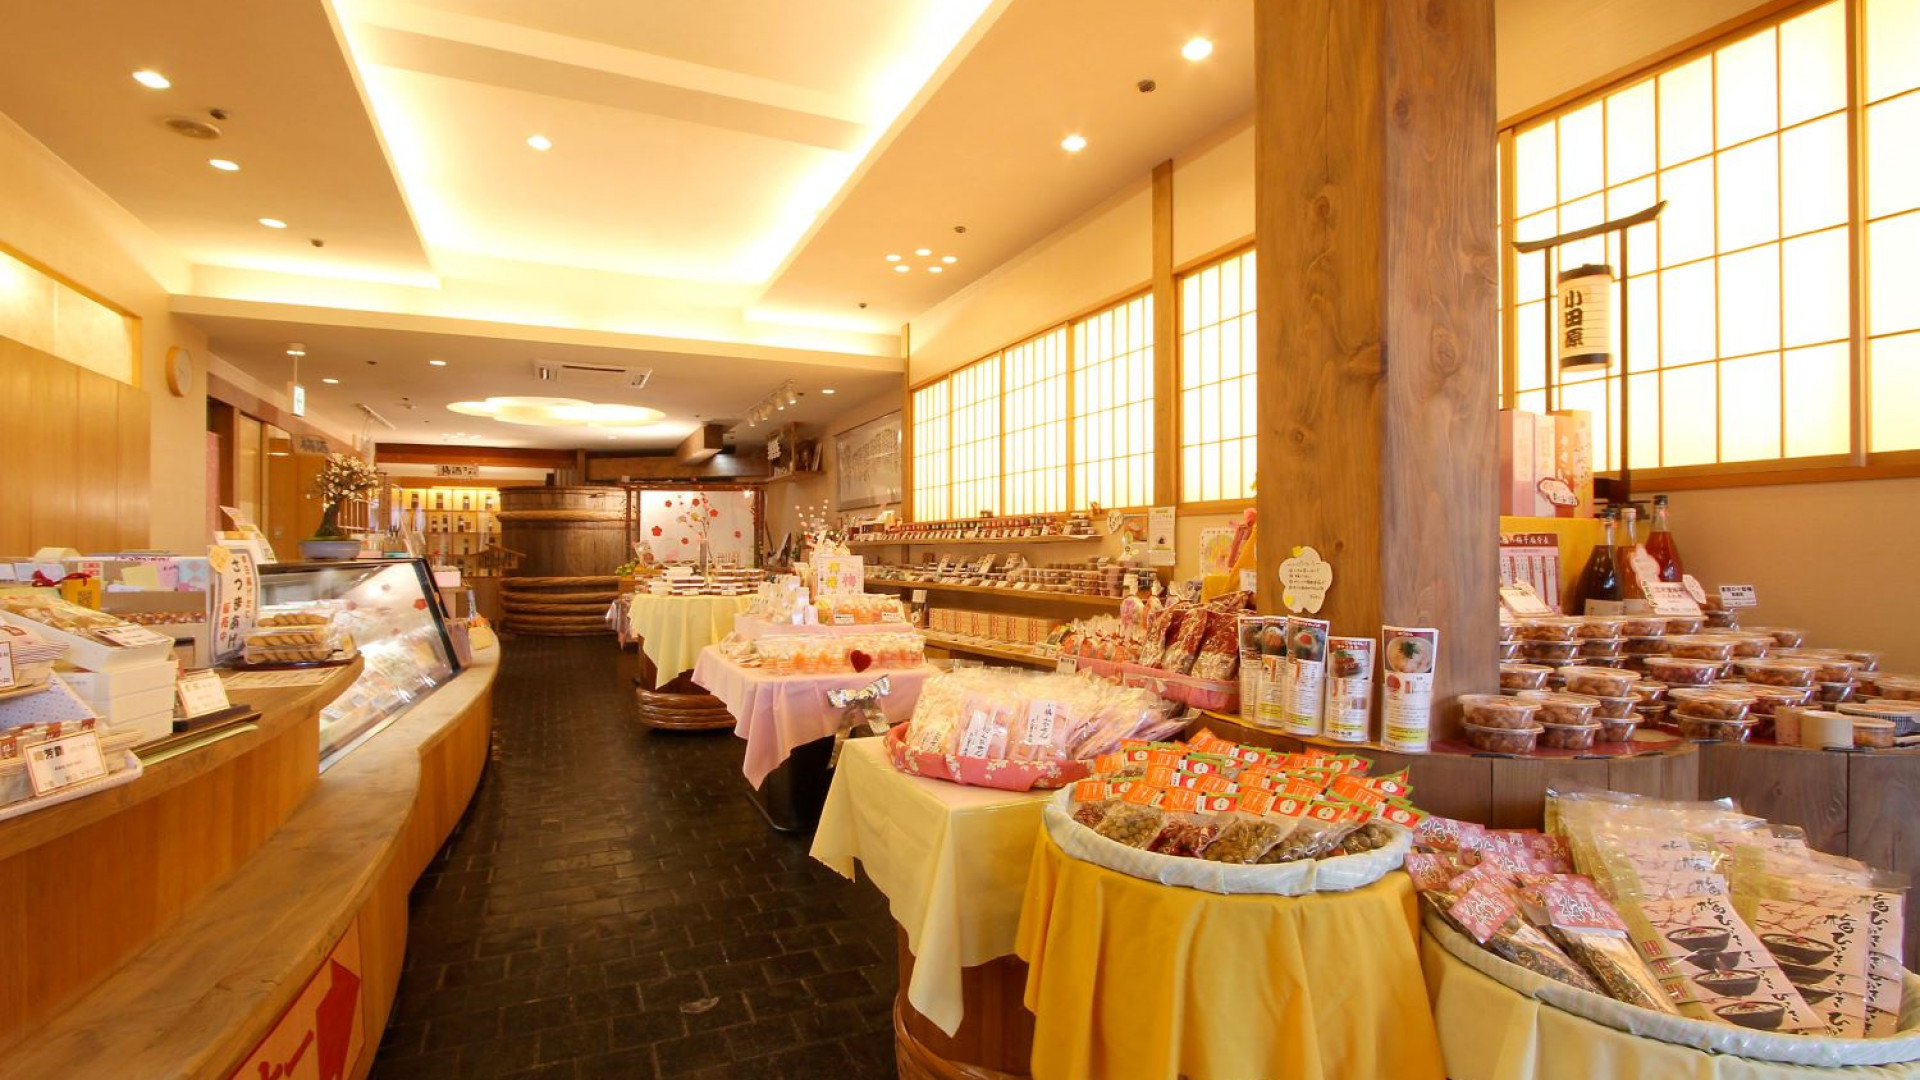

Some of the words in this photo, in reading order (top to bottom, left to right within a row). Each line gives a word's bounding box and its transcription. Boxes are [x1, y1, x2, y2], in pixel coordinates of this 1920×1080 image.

[1564, 290, 1584, 348] 小田原
[227, 559, 243, 649] さつまあげ
